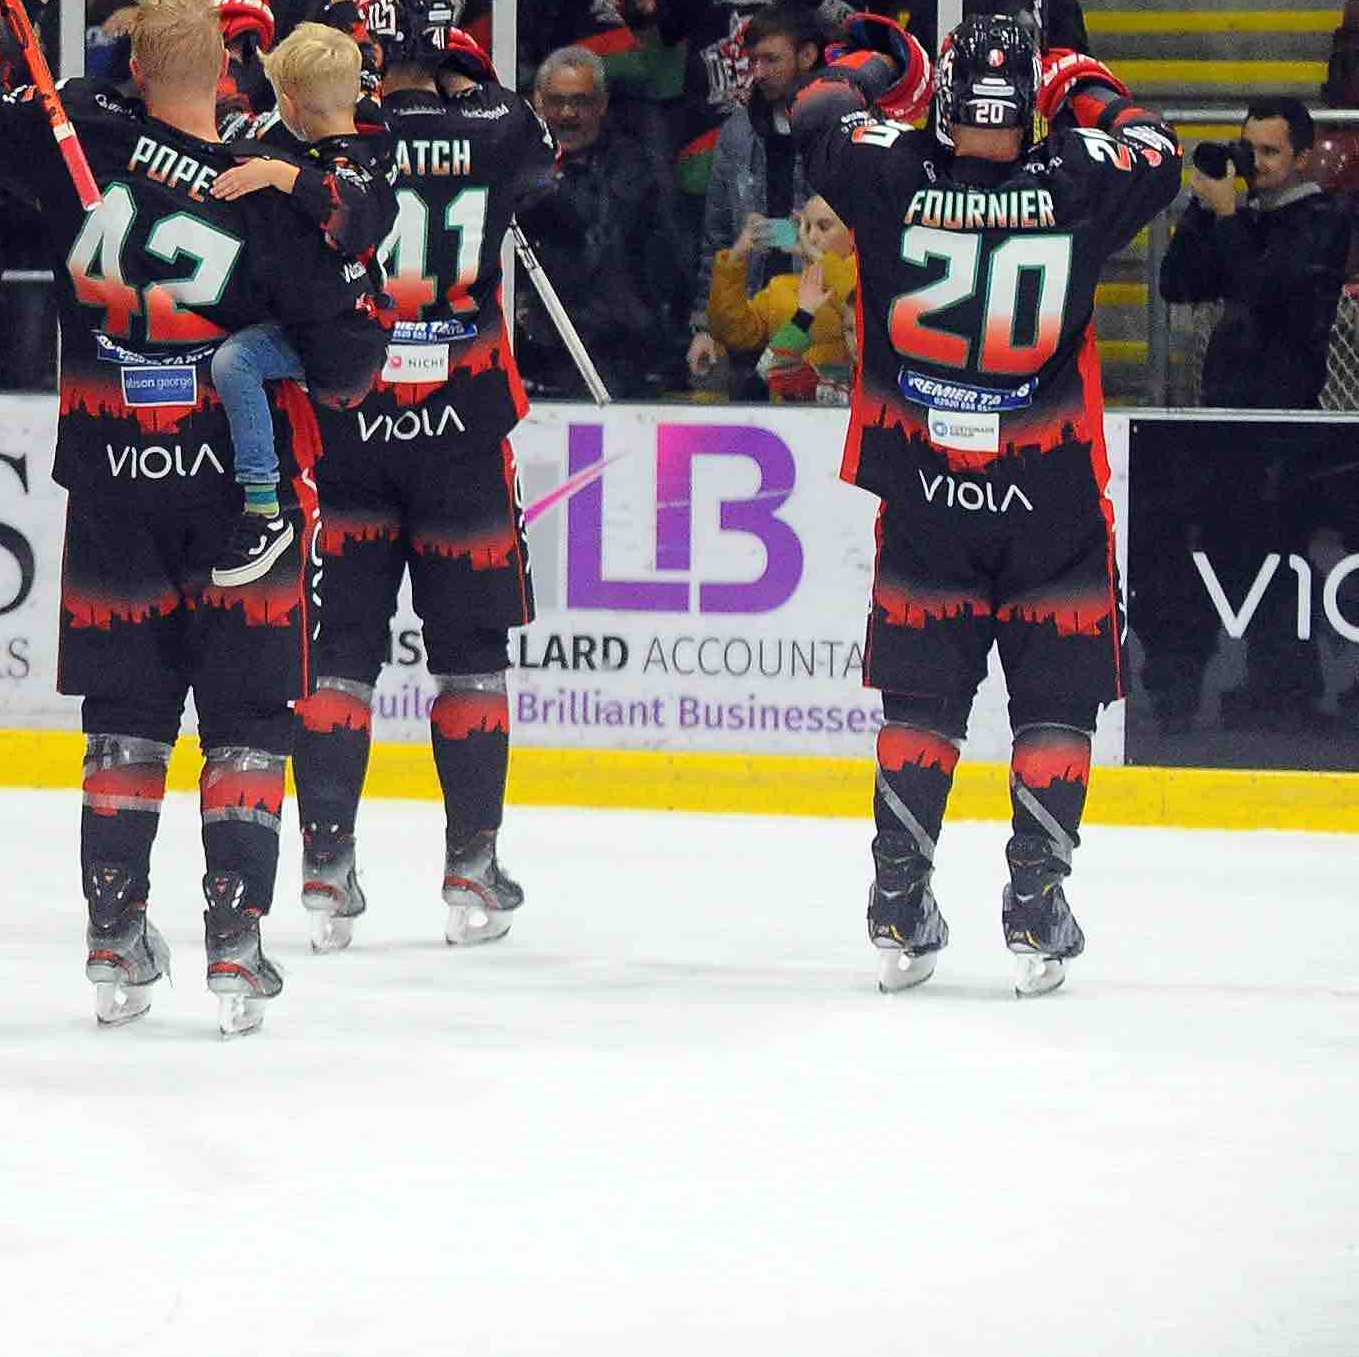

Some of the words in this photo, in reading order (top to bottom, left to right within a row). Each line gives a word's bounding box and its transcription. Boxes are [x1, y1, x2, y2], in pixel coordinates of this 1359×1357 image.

[975, 101, 1005, 125] 20
[394, 138, 473, 179] ATCH
[903, 187, 1057, 230] FOURNIER
[65, 179, 245, 342] 42
[887, 224, 1073, 374] 20
[356, 403, 466, 443] VIOLA
[105, 443, 226, 480] VIOLA
[917, 467, 1034, 513] VIOLA
[642, 639, 864, 679] ACCOUNTA
[516, 692, 666, 728] Brilliant
[678, 696, 884, 734] Businesses
